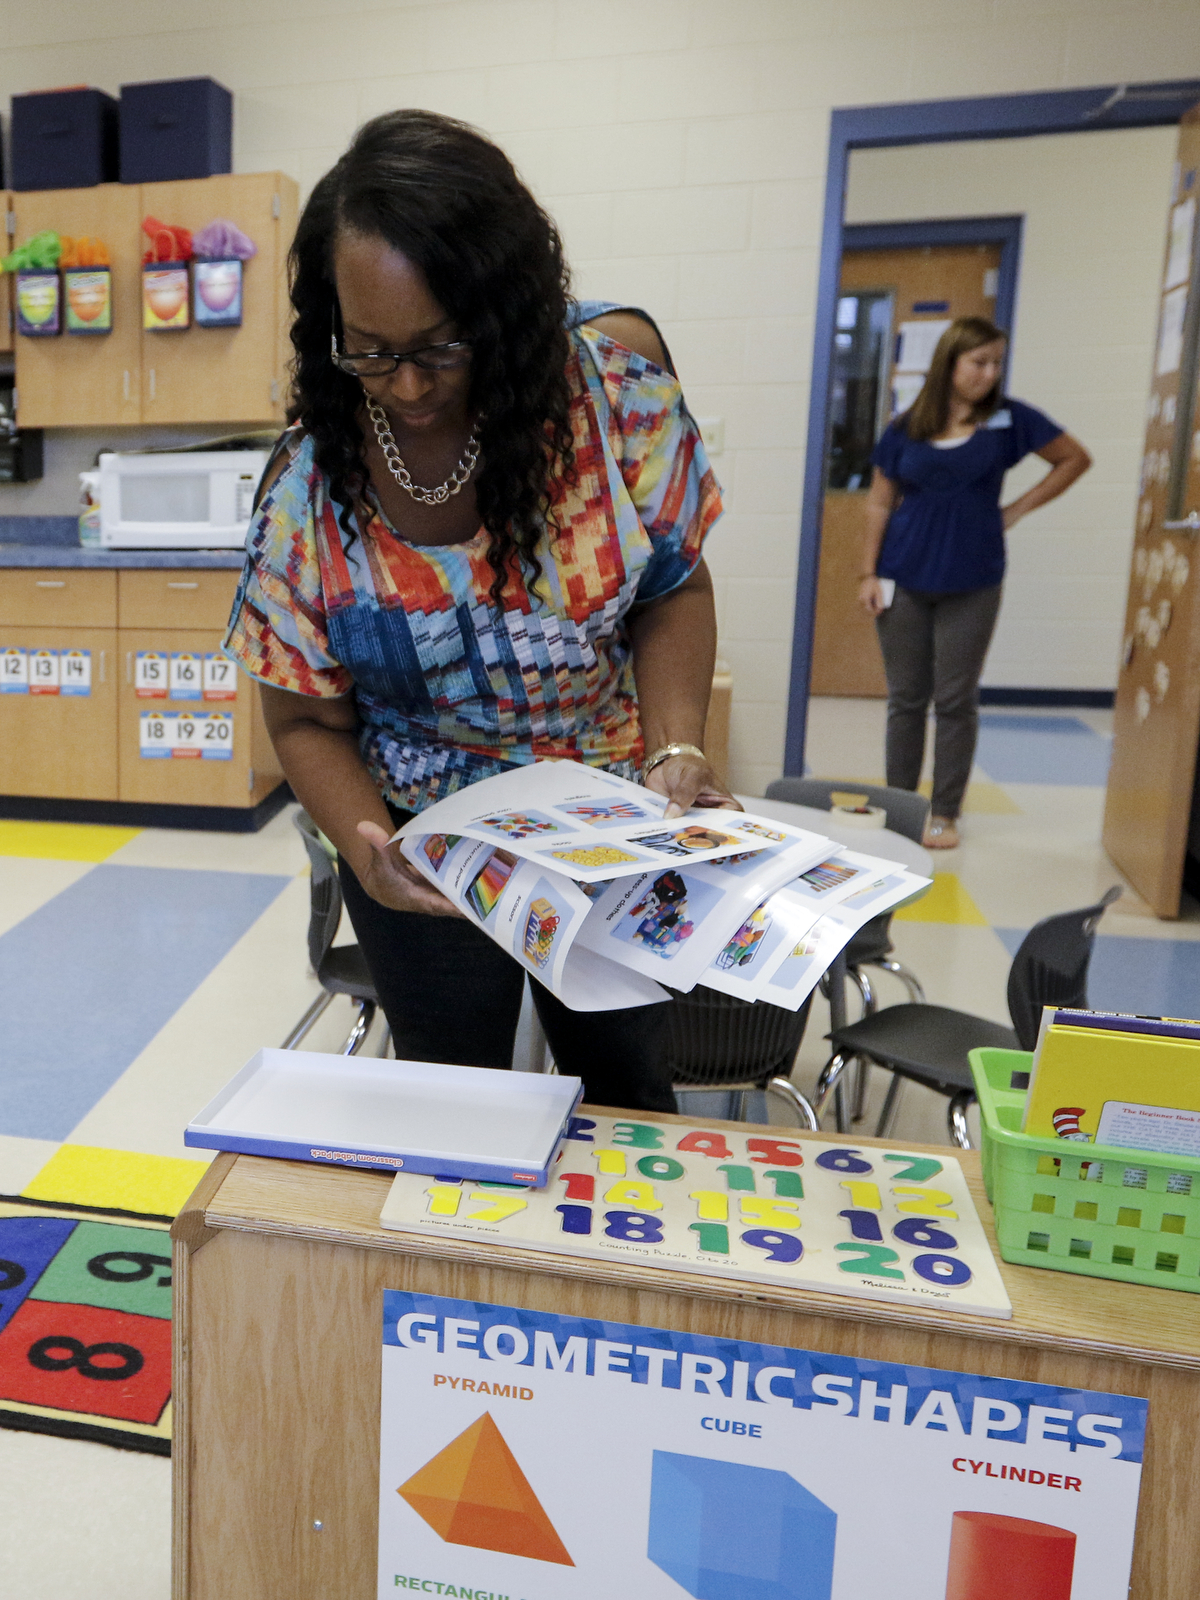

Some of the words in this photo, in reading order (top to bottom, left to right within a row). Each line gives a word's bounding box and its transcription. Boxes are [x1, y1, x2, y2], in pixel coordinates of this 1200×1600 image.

[4, 657, 21, 675] 12
[36, 659, 52, 676] 13
[66, 659, 84, 677] 14
[143, 663, 160, 679] 15
[177, 664, 194, 680] 16
[211, 664, 228, 681] 17
[147, 721, 165, 739] 18
[178, 722, 195, 739] 19
[205, 723, 229, 741] 20
[624, 873, 648, 899] dress-up
[509, 895, 521, 922] scissors
[606, 899, 626, 921] clothes
[1139, 1110, 1174, 1119] Beginner
[310, 1148, 332, 1159] Pack
[332, 1150, 357, 1162] Label
[358, 1154, 404, 1167] Classroom
[612, 1122, 665, 1150] 3
[677, 1131, 733, 1159] 4
[747, 1138, 804, 1167] 5
[815, 1149, 874, 1174] 6
[884, 1154, 943, 1182] 7
[426, 1185, 528, 1222] 17
[420, 1218, 451, 1227] pictures
[599, 1241, 649, 1256] Counting
[861, 1279, 908, 1291] Melissa
[27, 1335, 145, 1381] 8
[397, 1312, 796, 1413] GEOMETRIC
[811, 1373, 1124, 1461] SHAPES
[433, 1374, 534, 1401] PYRAMID
[701, 1416, 762, 1438] CUBE
[952, 1457, 1083, 1492] CYLINDER
